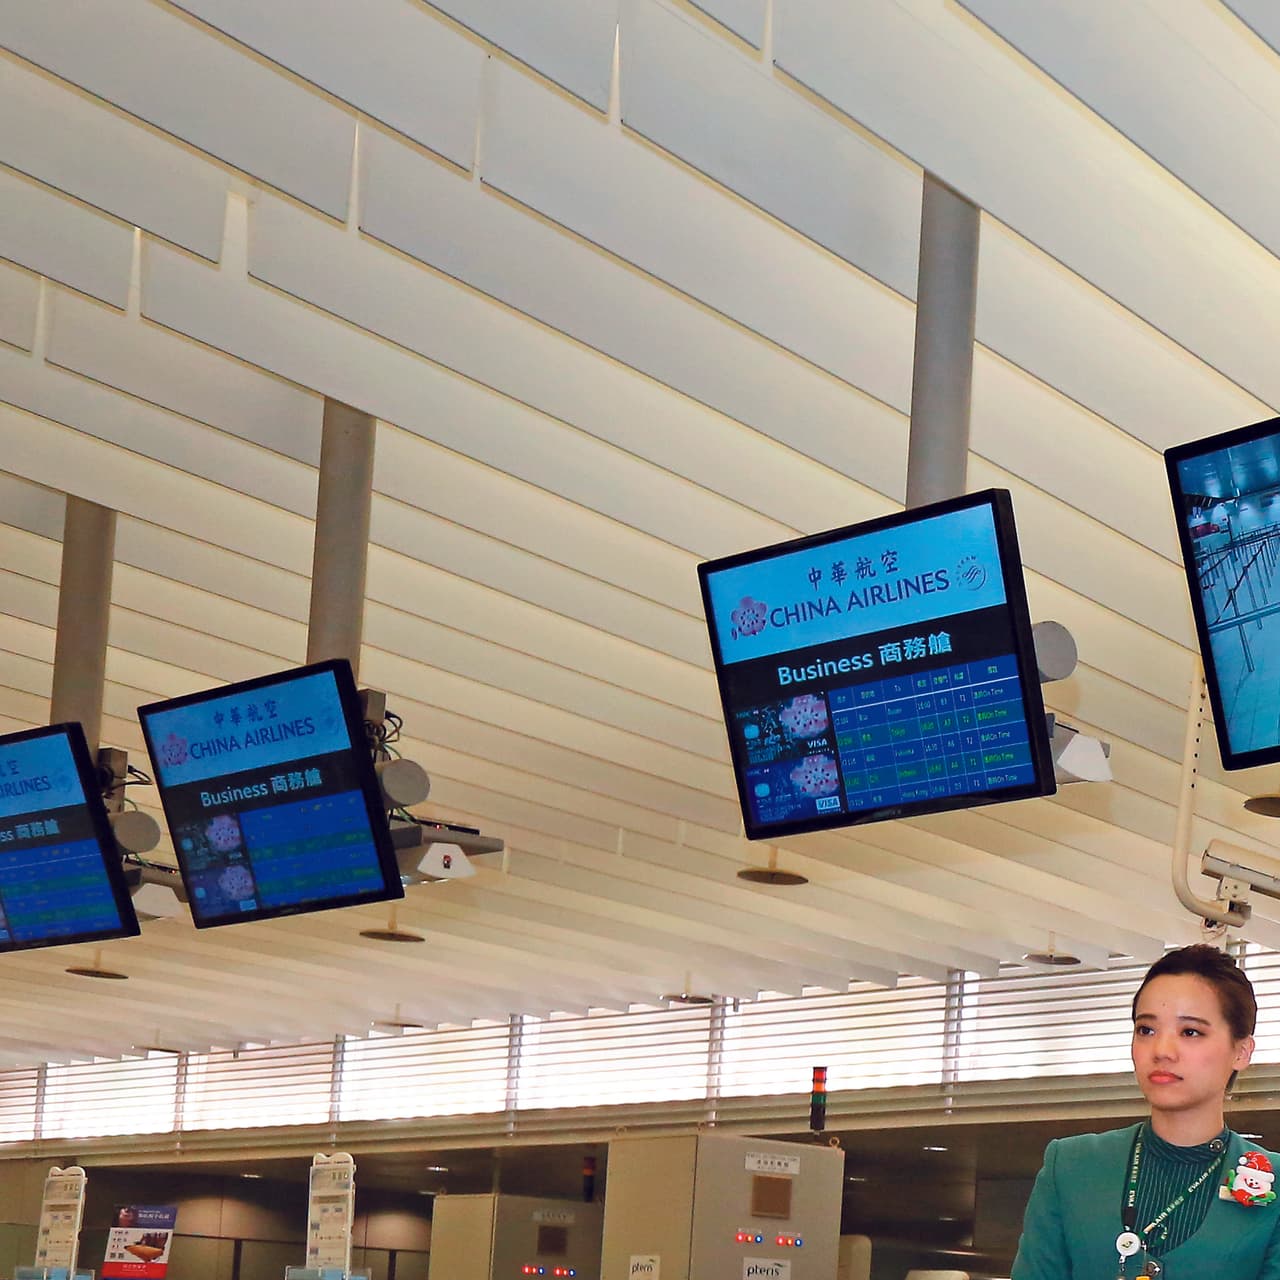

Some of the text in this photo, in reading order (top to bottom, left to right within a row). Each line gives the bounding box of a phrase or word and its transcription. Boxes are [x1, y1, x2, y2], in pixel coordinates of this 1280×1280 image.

[808, 549, 899, 591] 中華航空
[770, 569, 950, 627] CHINA AIRLINES
[777, 631, 952, 686] Business 商務艙
[190, 717, 316, 760] CHINA AIRLINES
[807, 738, 828, 749] VISA
[201, 782, 268, 807] Business
[632, 1261, 653, 1274] pteris
[747, 1264, 780, 1277] pteris
